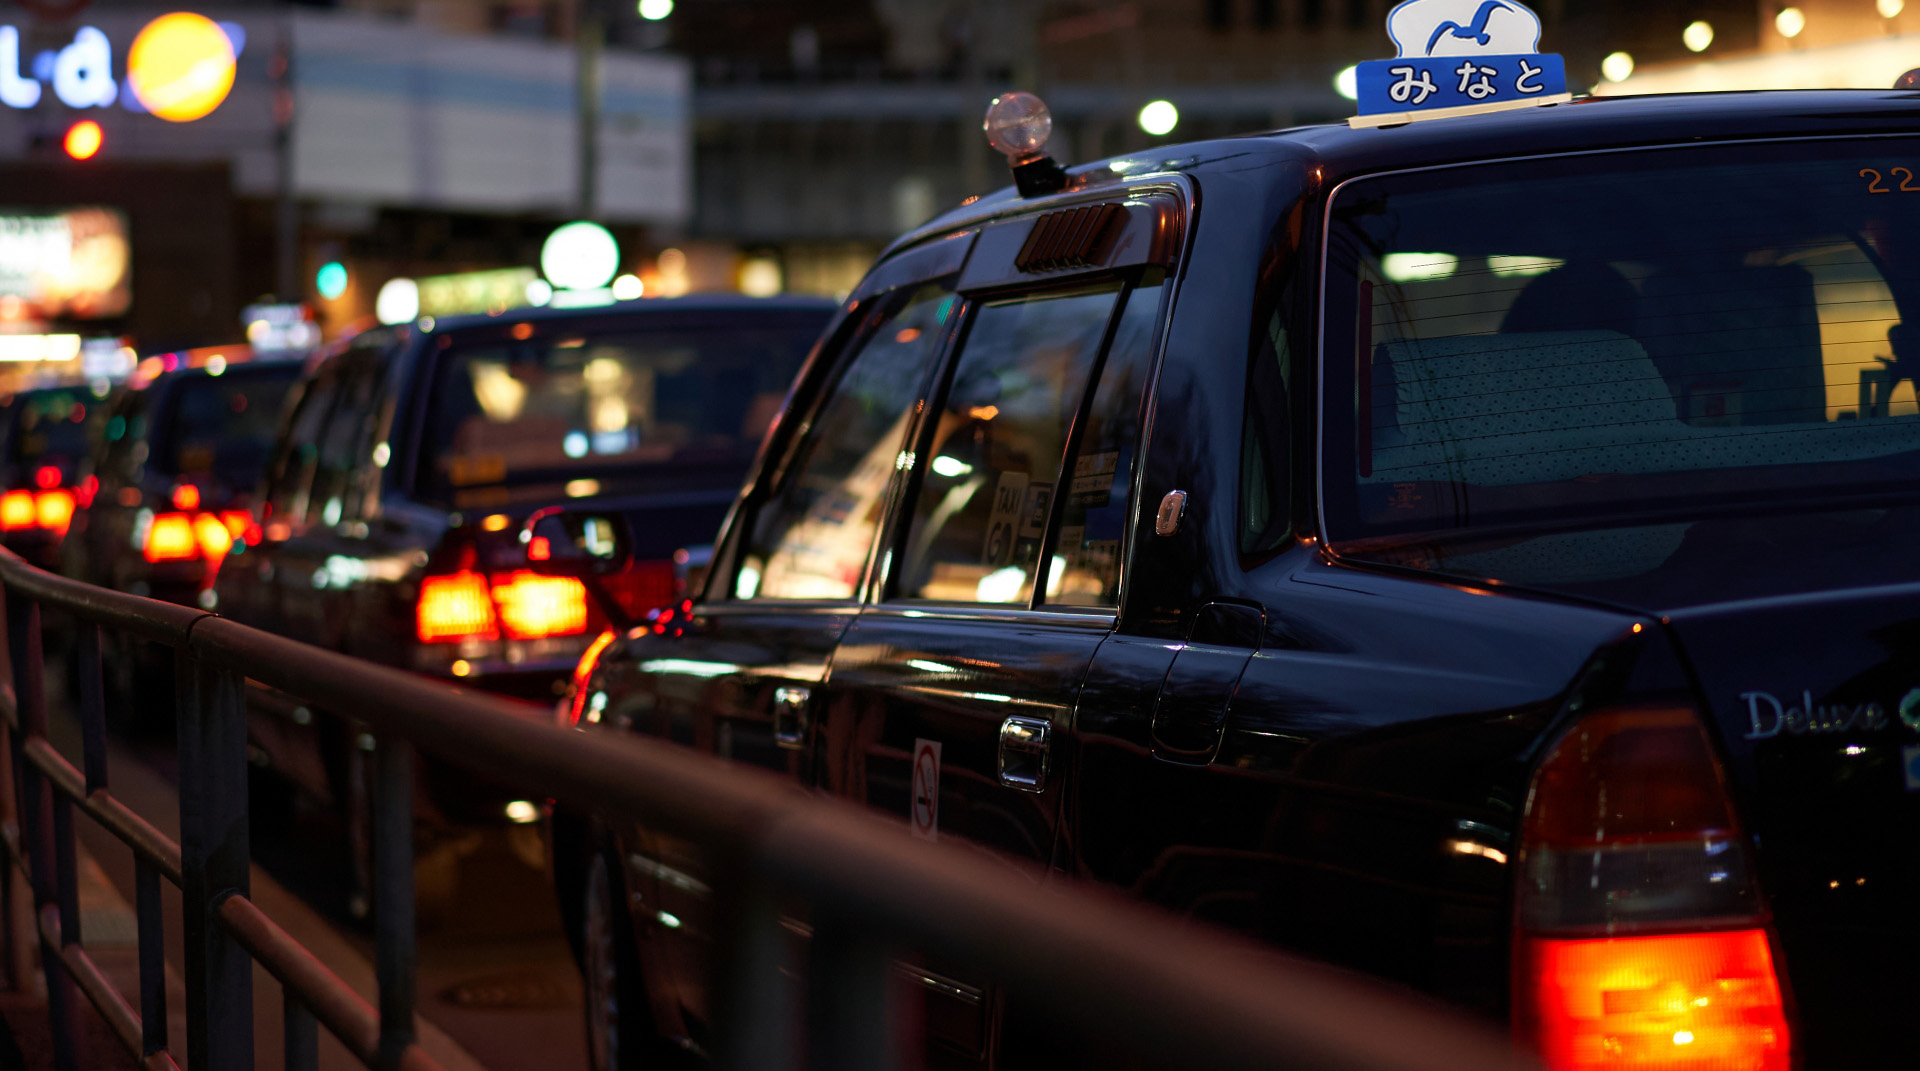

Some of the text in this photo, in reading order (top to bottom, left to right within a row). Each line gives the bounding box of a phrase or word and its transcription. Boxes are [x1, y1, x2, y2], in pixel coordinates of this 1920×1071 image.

[1388, 59, 1545, 105] みなと
[997, 486, 1022, 514] TAXI
[988, 521, 1012, 565] GO
[1738, 688, 1890, 741] Deluxe
